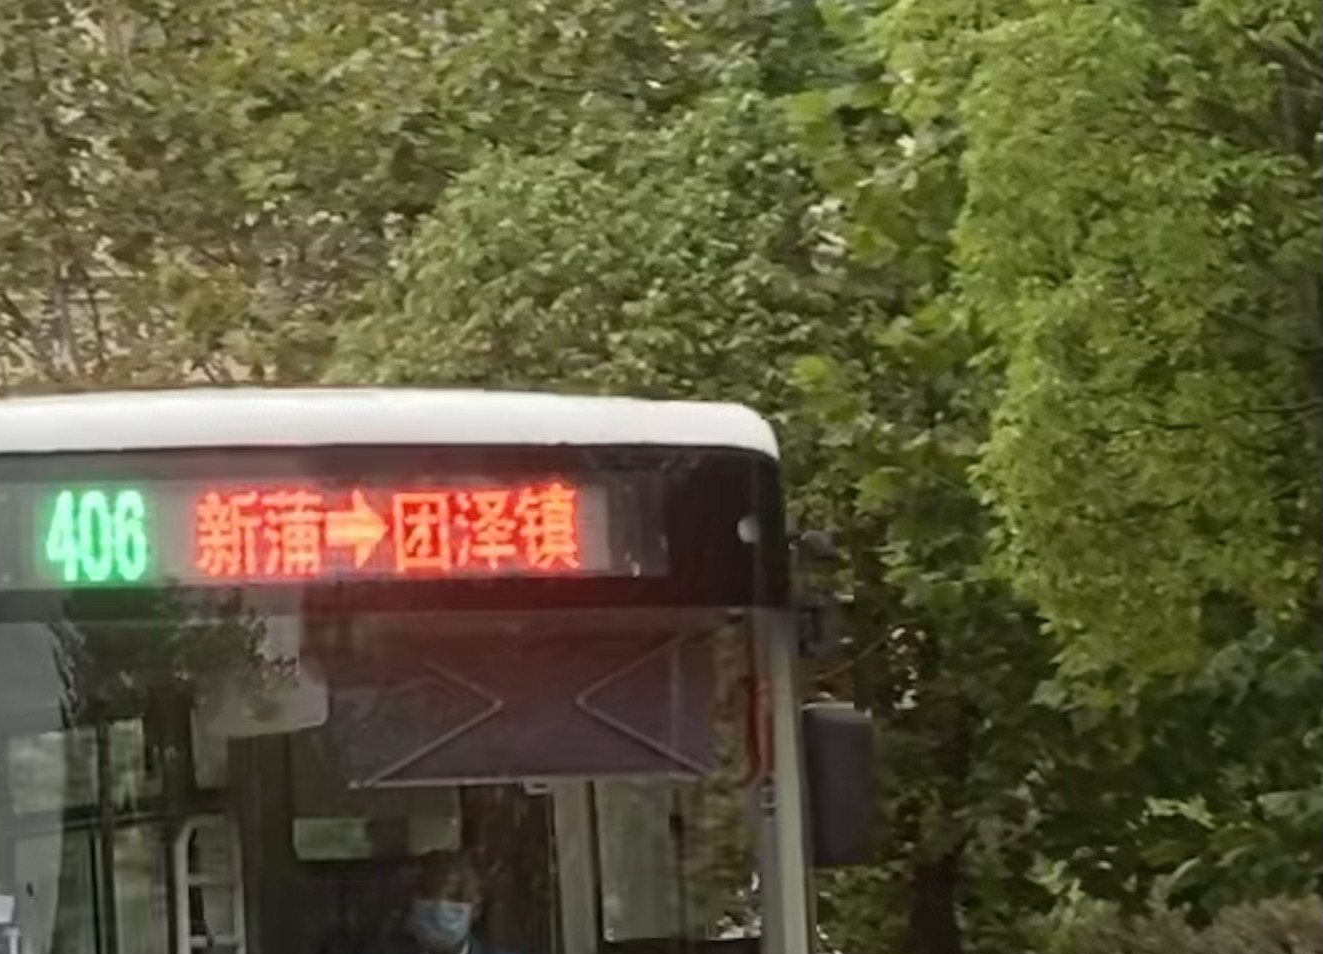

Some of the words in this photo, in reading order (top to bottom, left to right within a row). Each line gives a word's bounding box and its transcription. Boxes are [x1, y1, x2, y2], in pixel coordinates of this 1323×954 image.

[45, 489, 148, 581] 406
[194, 487, 323, 577] 新蒲
[392, 481, 580, 571] 团泽镇
